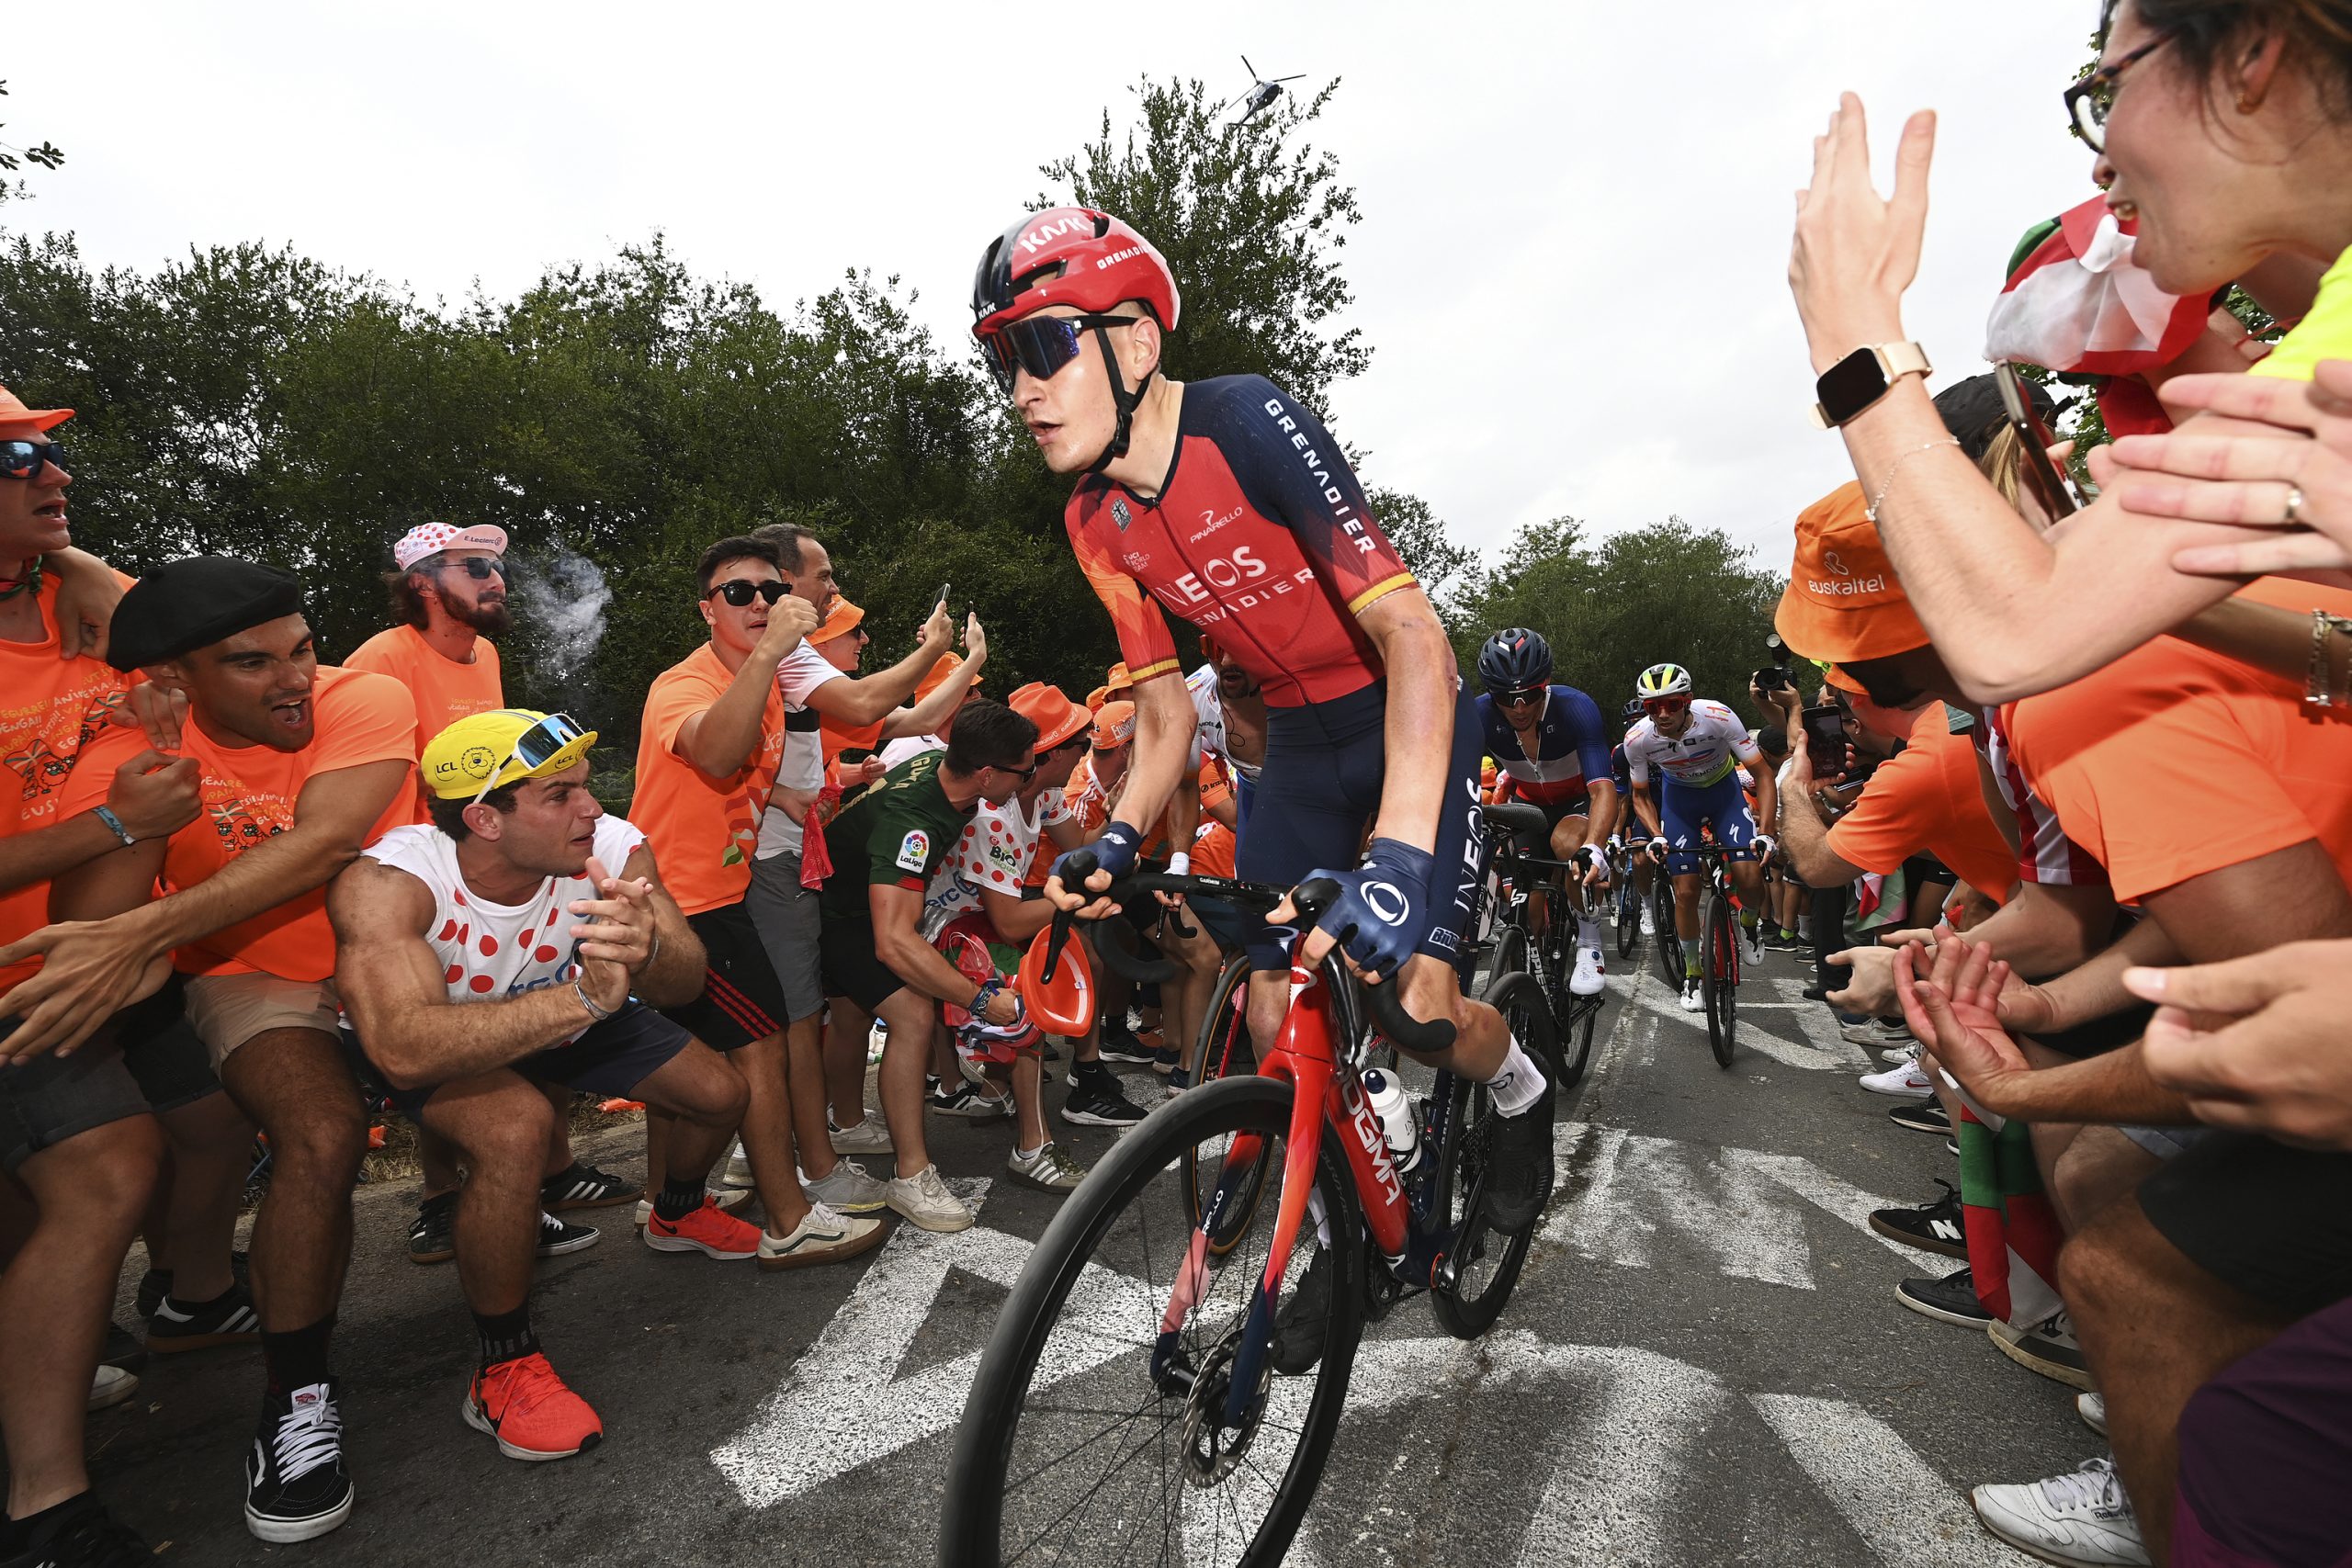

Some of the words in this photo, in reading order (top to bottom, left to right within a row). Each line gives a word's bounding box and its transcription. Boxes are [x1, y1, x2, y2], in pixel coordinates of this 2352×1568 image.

[1020, 217, 1089, 254] KASK
[1264, 398, 1376, 554] GRENADIER
[1190, 507, 1243, 544] PINARELLO
[1193, 567, 1316, 626] ENADIER
[1808, 573, 1885, 595] euskaltel
[435, 761, 458, 773] LCL
[557, 754, 573, 765] LCL
[899, 855, 922, 867] LaLiga
[1453, 777, 1483, 913] INEOS
